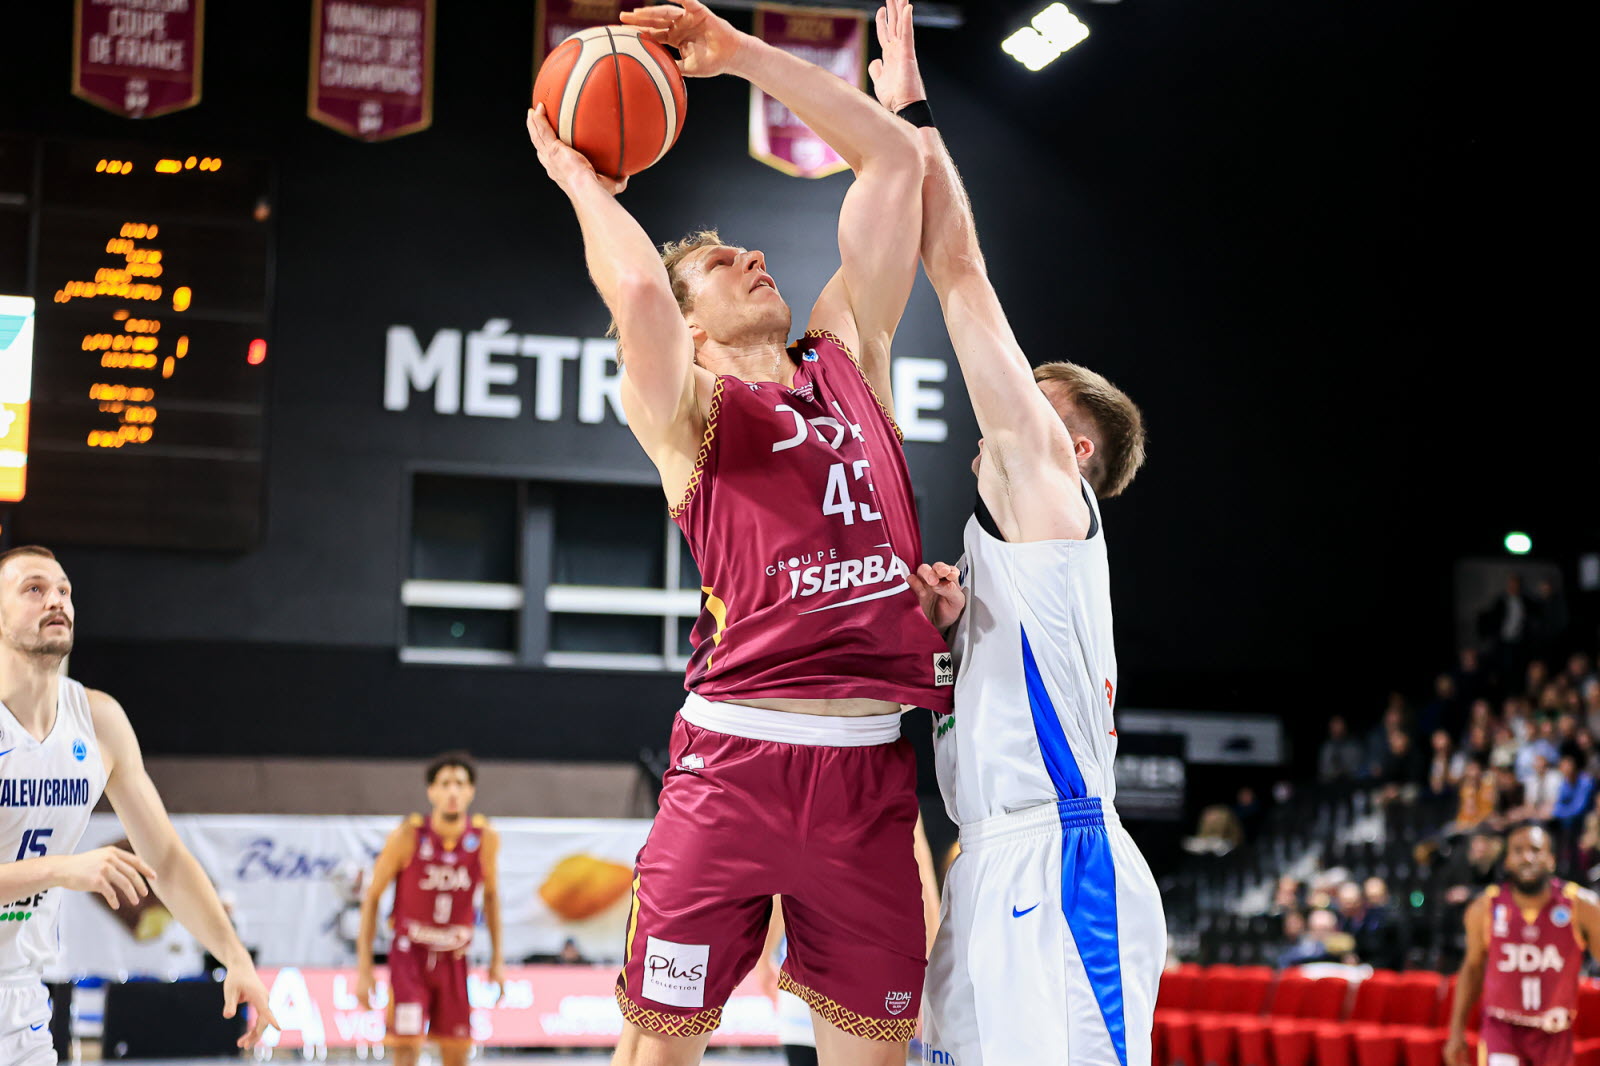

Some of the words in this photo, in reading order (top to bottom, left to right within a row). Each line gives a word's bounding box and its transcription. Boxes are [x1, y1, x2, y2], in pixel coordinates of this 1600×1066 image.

[108, 8, 168, 41] COUPE
[88, 33, 111, 64] DE
[115, 38, 185, 71] FRANCE
[822, 459, 882, 526] 43
[765, 548, 838, 577] GROUPE
[936, 672, 954, 685] erre
[15, 828, 54, 862] 15
[418, 864, 472, 892] JDA
[649, 954, 704, 982] Plus
[1496, 943, 1566, 973] JDA
[650, 978, 698, 992] COLLECTION
[1521, 976, 1542, 1011] 11
